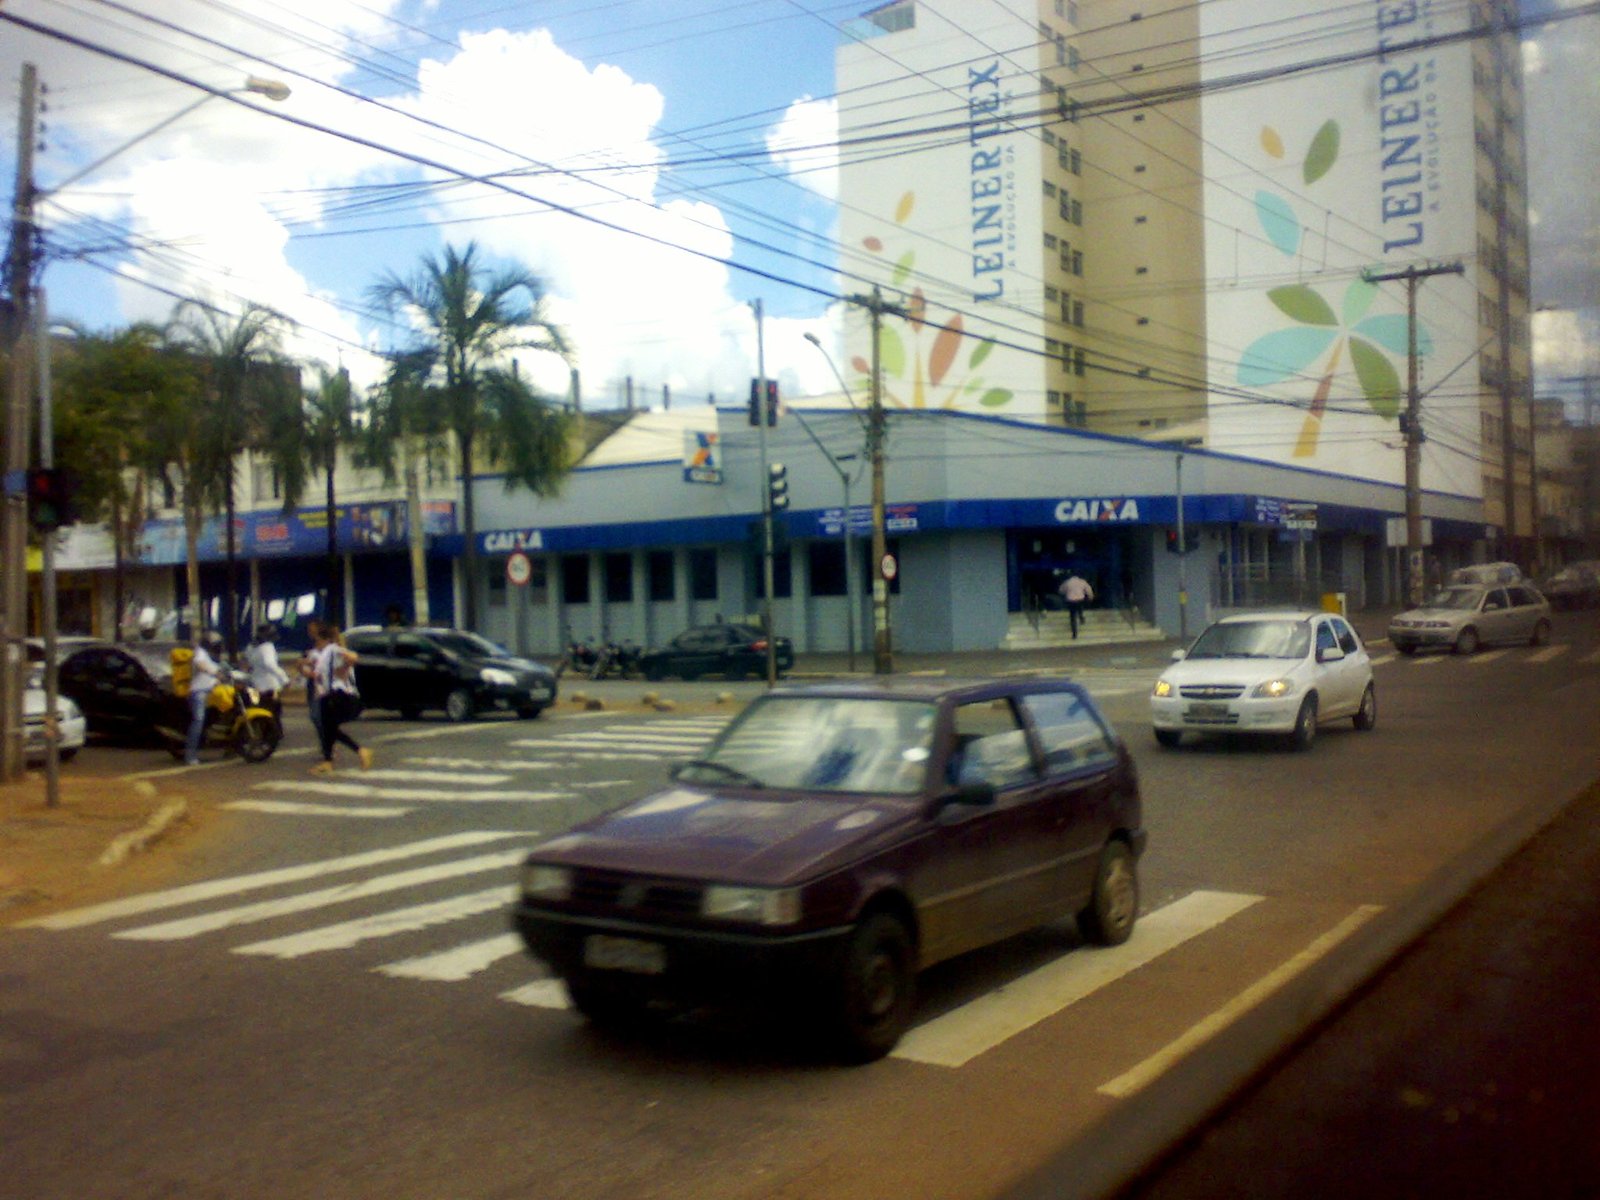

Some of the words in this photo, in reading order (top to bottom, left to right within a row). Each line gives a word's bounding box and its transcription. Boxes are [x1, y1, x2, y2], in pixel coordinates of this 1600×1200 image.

[969, 60, 1005, 304] LEINERTEX
[1377, 0, 1424, 254] LEINERTE
[484, 531, 543, 552] CAIXA
[1055, 499, 1138, 522] CAIXA
